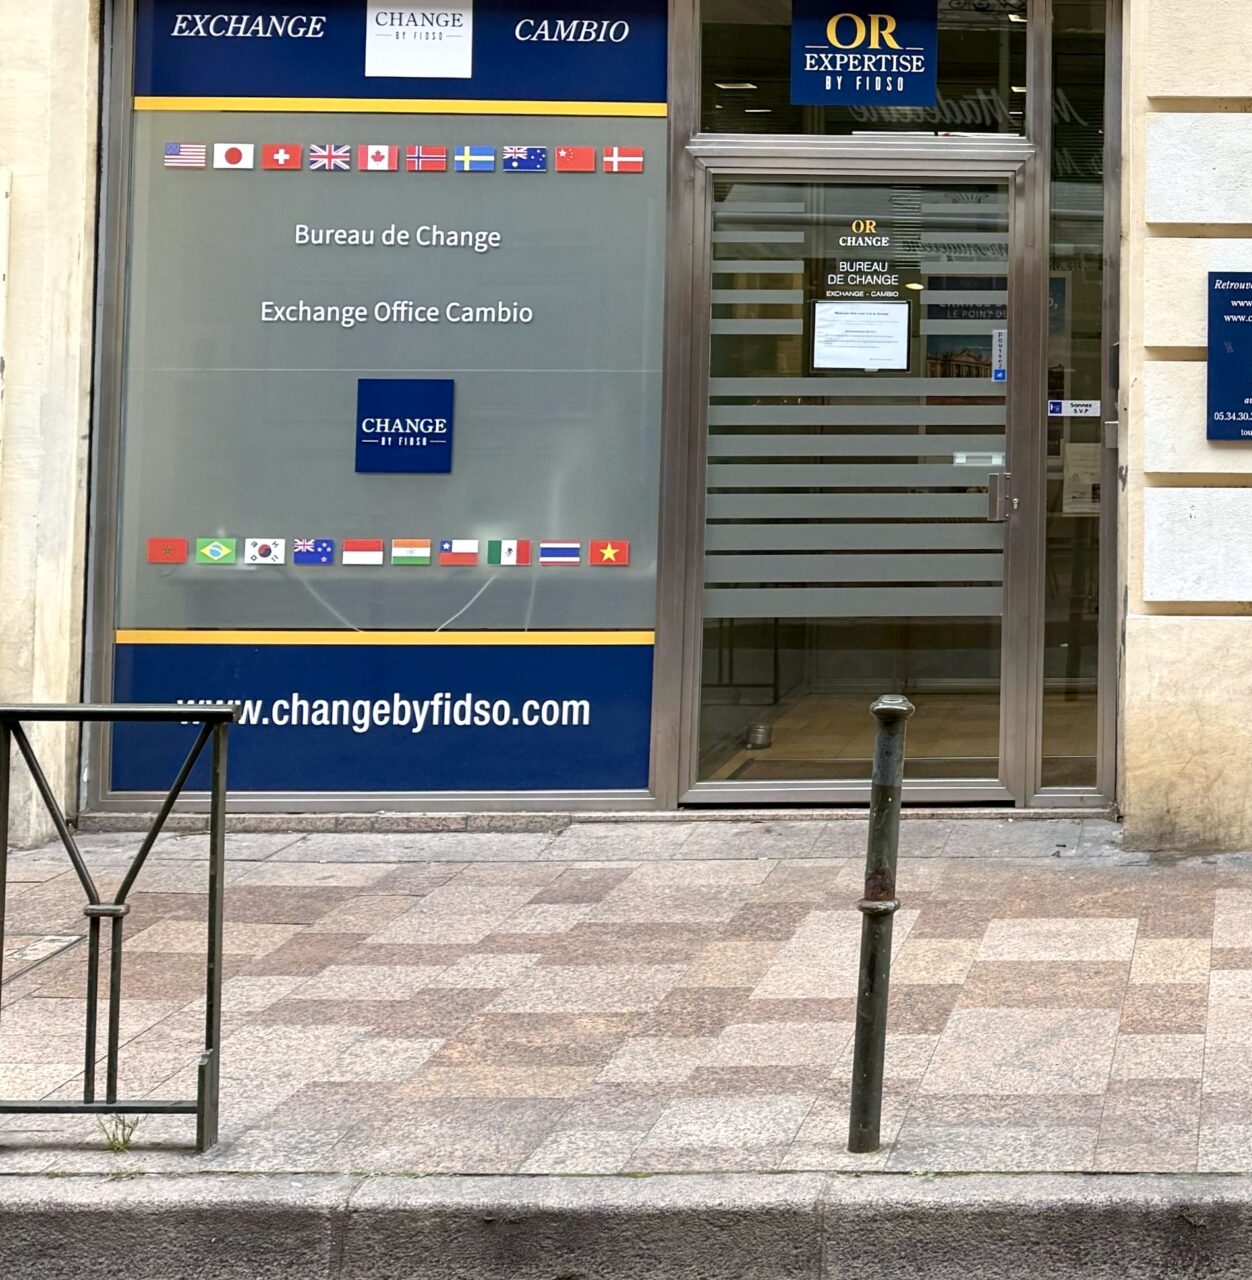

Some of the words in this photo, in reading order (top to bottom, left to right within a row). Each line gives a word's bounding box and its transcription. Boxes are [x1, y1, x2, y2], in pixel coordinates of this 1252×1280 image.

[171, 15, 326, 38] EXCHANGE
[375, 11, 464, 28] CHANGE
[395, 31, 407, 40] BY
[414, 31, 443, 41] FIDSO
[515, 20, 629, 43] CAMBIO
[826, 13, 901, 50] OR
[804, 54, 924, 73] EXPERTISE
[825, 76, 841, 91] BY
[856, 76, 904, 92] FIDSO
[852, 219, 877, 233] OR
[295, 224, 374, 246] Bureau
[381, 225, 410, 246] de
[415, 226, 501, 251] Change
[839, 236, 889, 246] CHANGE
[839, 261, 888, 272] BUREAU
[827, 275, 844, 285] DE
[848, 275, 899, 285] CHANGE
[261, 301, 368, 326] Exchange
[373, 300, 439, 323] Office
[446, 301, 533, 323] Cambio
[362, 418, 446, 433] CHANGE
[381, 436, 392, 446] BY
